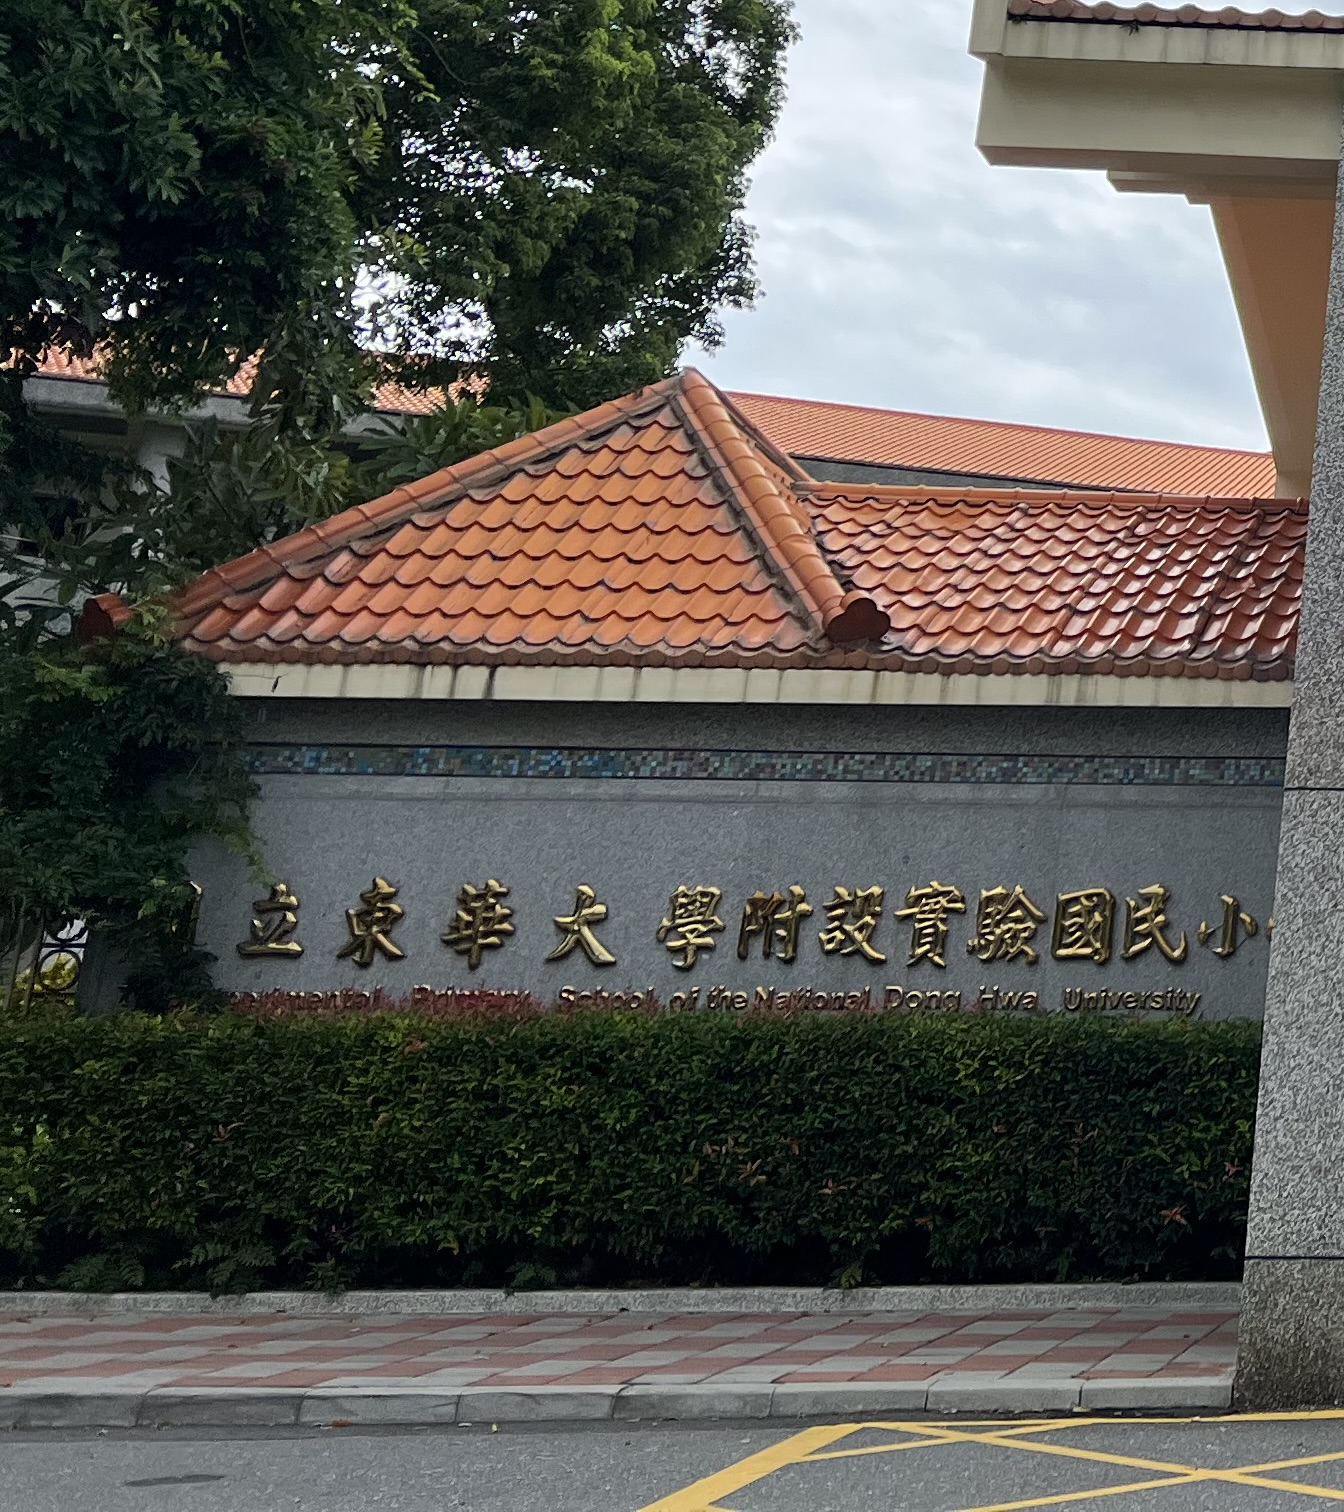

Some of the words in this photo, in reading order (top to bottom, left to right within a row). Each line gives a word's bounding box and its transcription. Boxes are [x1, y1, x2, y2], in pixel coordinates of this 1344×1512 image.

[187, 876, 1275, 969] 立東華大學附設實驗國民小
[707, 984, 749, 1010] the
[885, 984, 961, 1011] Dong
[978, 983, 1039, 1010] Hwa
[1061, 985, 1202, 1016] University
